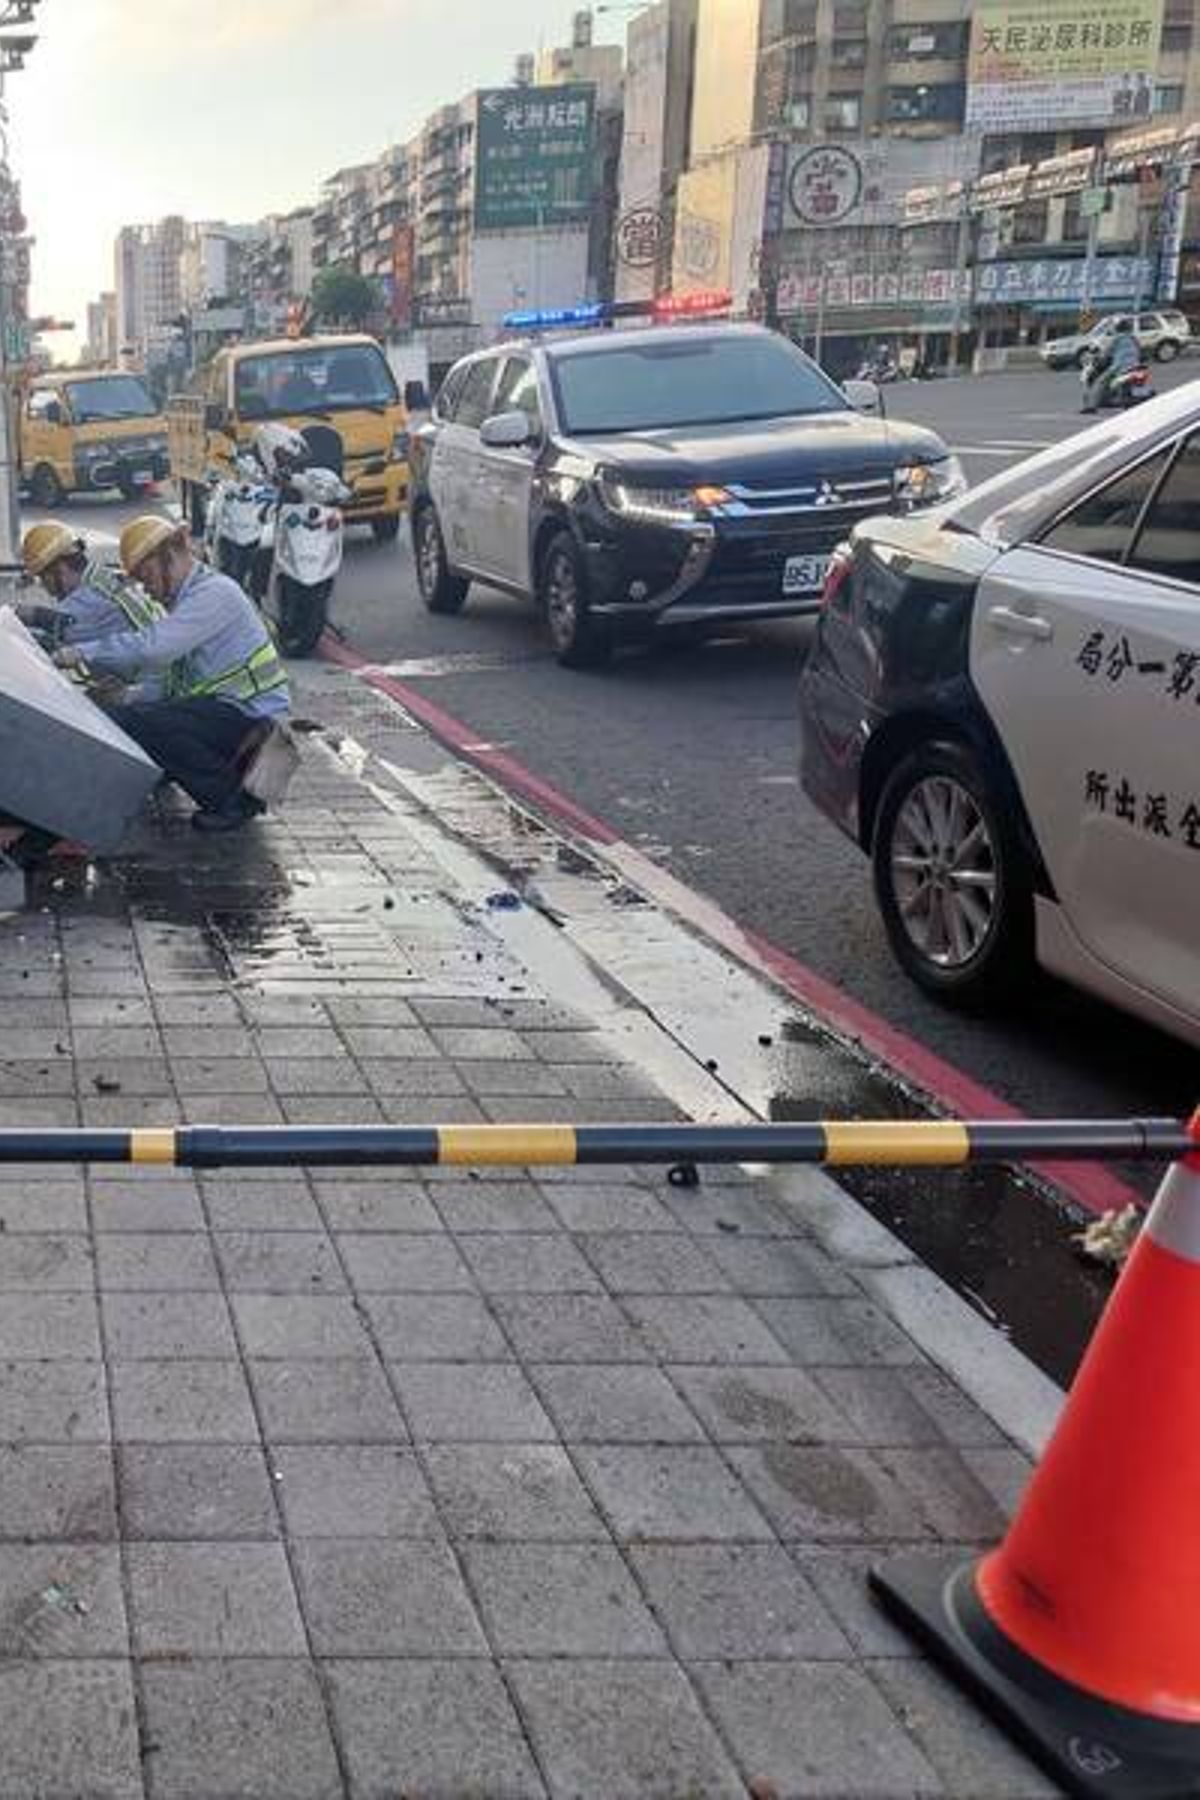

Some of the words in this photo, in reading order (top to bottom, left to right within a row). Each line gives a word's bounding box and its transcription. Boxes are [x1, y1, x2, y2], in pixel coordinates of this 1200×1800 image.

[982, 21, 1152, 53] 天民泌尿科診所
